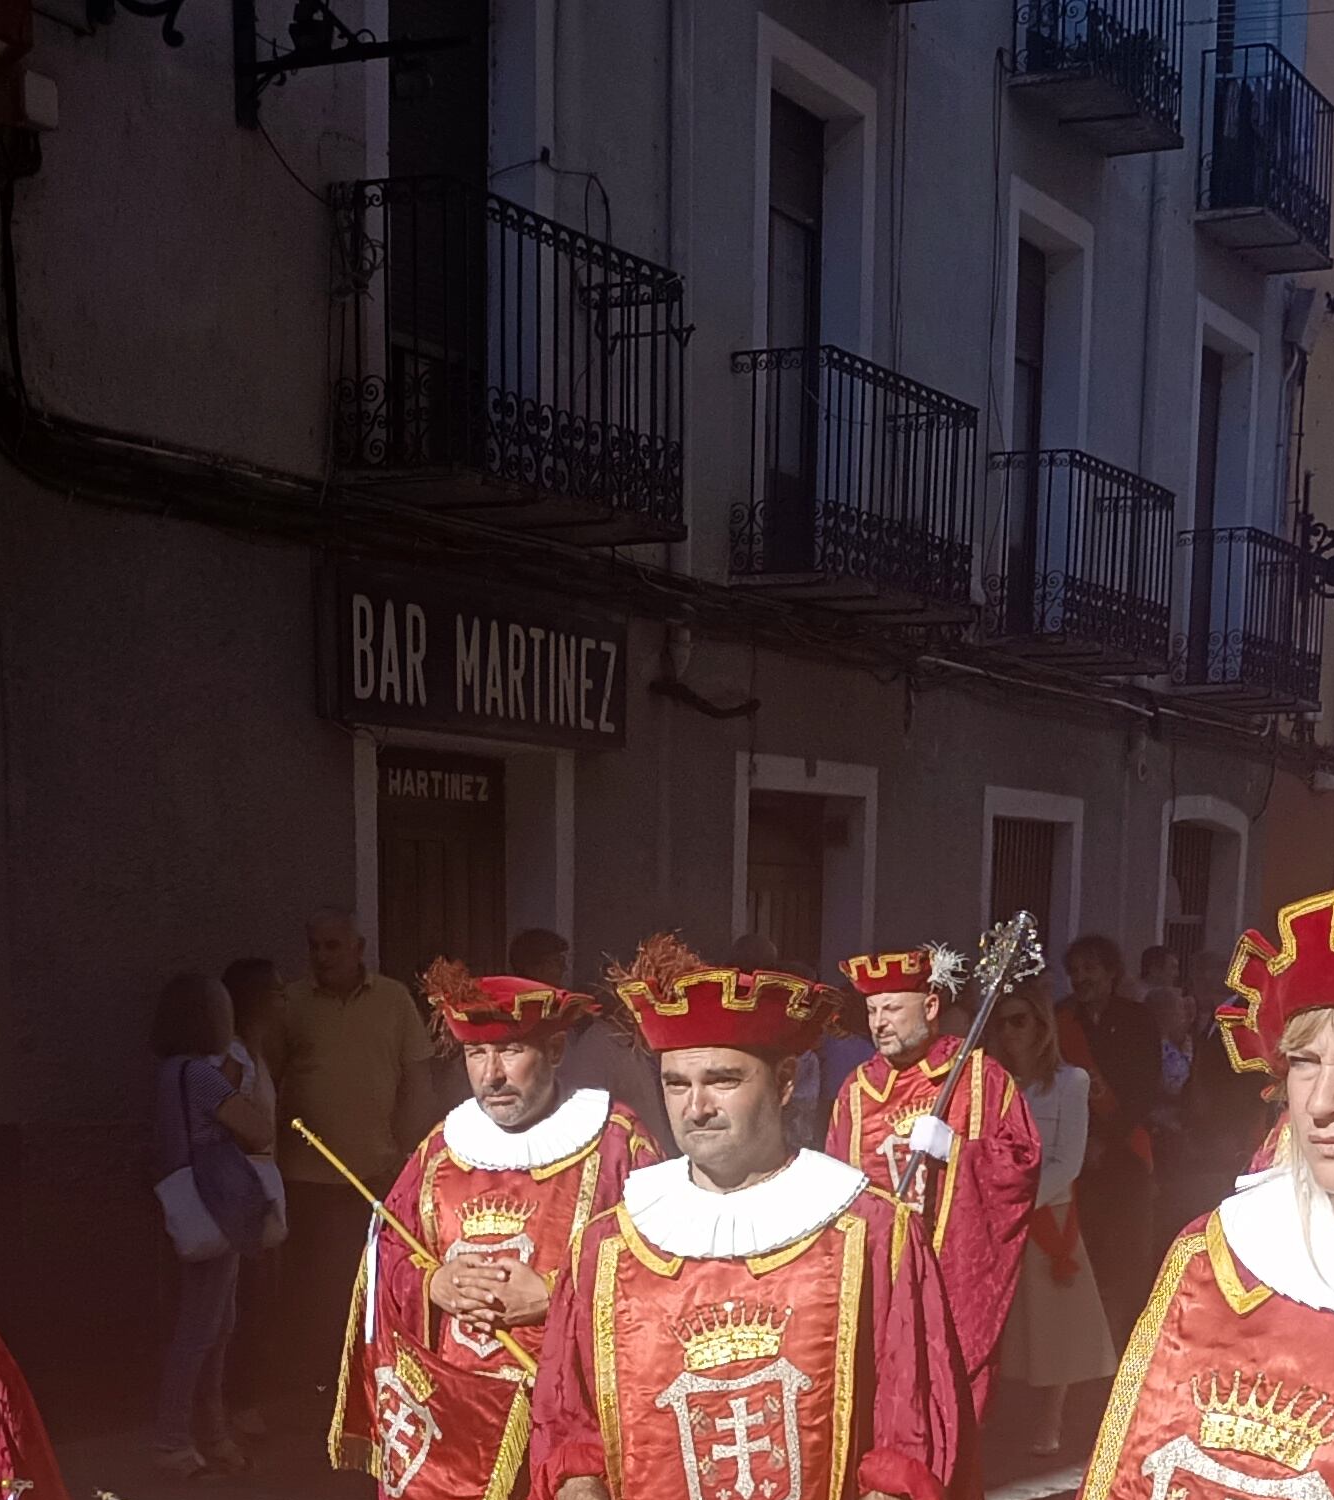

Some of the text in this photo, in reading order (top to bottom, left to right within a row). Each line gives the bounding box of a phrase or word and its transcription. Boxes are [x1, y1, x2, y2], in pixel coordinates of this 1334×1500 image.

[352, 593, 617, 734] BAR MARTINEZ
[388, 768, 489, 801] MARTINEZ
